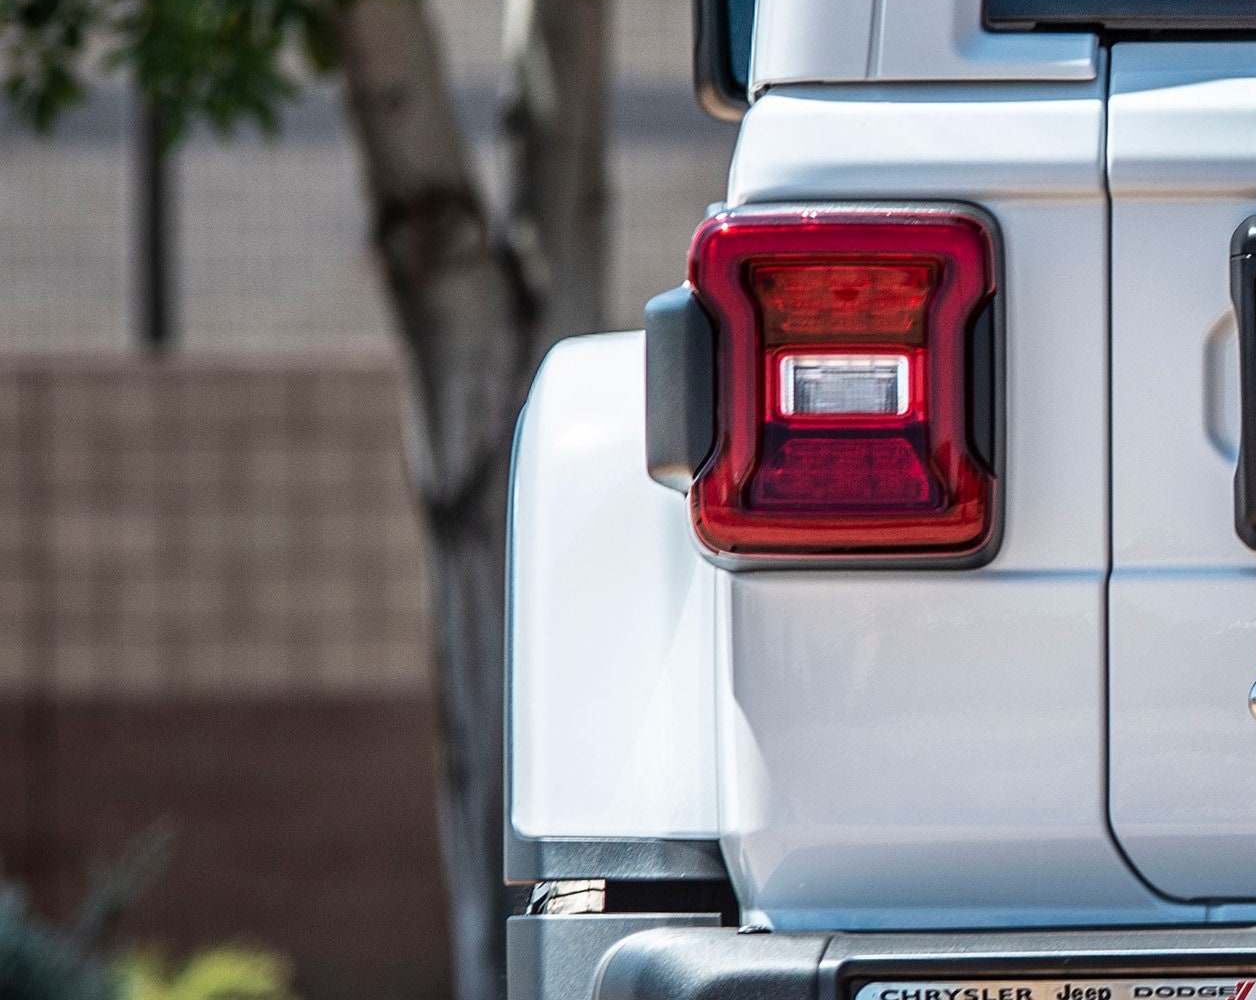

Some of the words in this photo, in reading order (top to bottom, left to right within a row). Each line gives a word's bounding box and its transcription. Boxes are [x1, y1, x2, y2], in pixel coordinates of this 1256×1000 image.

[879, 987, 1034, 1000] CHRYSLER
[1056, 983, 1112, 1000] Jeep
[1133, 985, 1237, 998] DODGE
